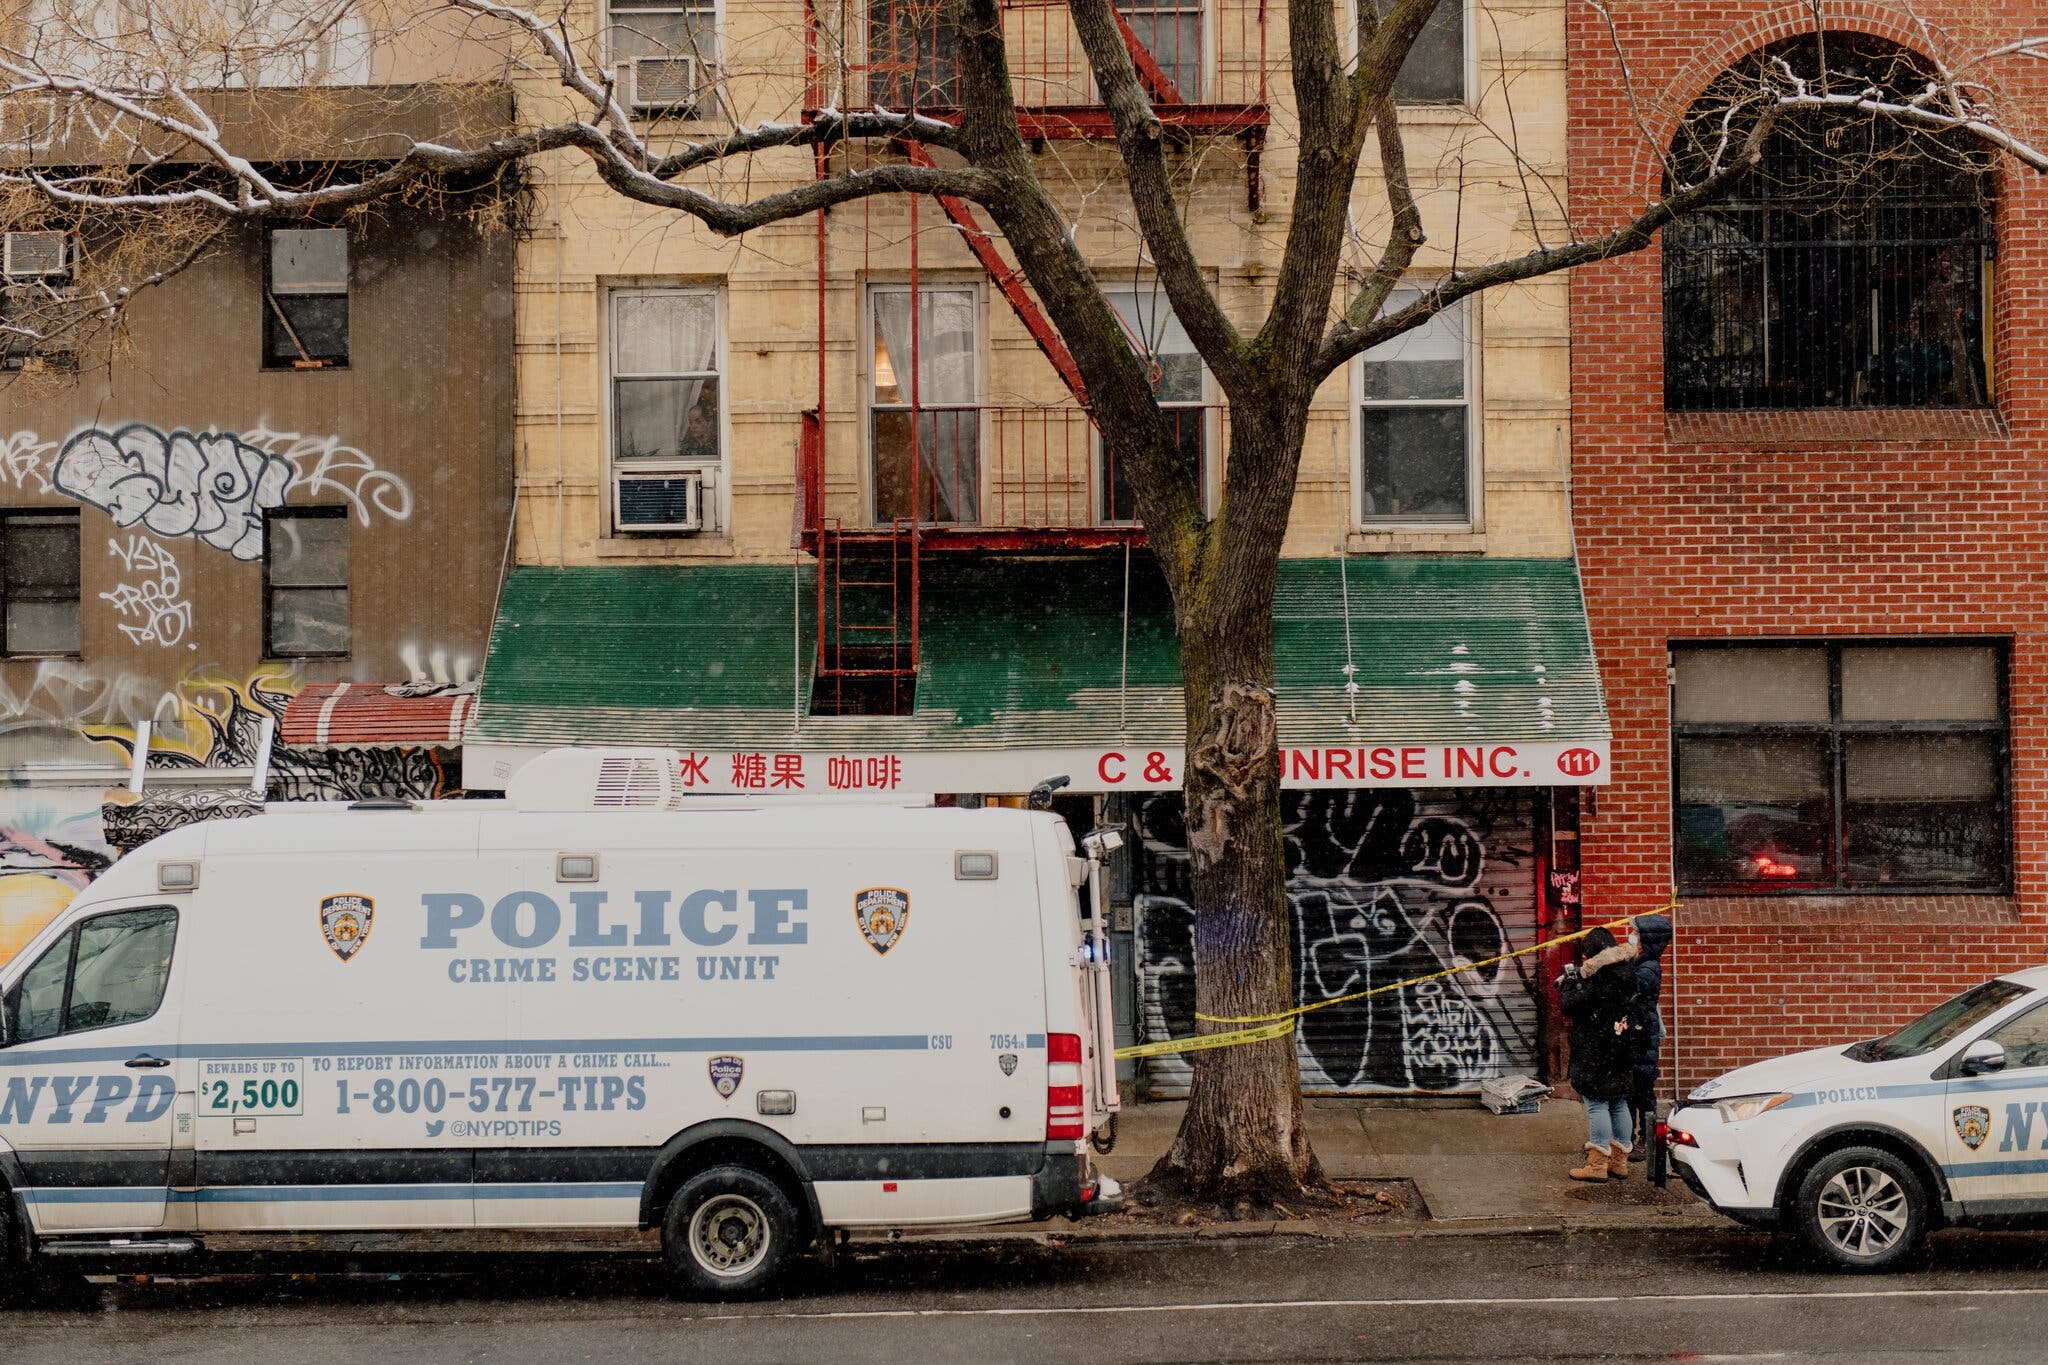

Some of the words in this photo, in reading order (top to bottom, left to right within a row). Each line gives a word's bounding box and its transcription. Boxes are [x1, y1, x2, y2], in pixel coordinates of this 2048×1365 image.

[679, 752, 710, 787] 水
[731, 752, 806, 789] 糖果
[828, 754, 902, 790] 咖啡
[1097, 752, 1127, 784] C
[1143, 751, 1173, 783] &
[1443, 746, 1530, 778] INC.
[1559, 752, 1597, 772] 111
[332, 896, 363, 904] POLICE
[868, 889, 897, 898] POLICE
[323, 903, 371, 916] DEPARTMENT
[858, 898, 907, 910] DEPARTMENT
[420, 888, 808, 950] POLICE
[448, 958, 556, 983] CRIME
[572, 957, 680, 982] SCENE
[696, 956, 779, 980] UNIT
[931, 1034, 953, 1050] CSU
[989, 1034, 1018, 1049] 7054
[206, 1062, 258, 1074] REWARDS
[262, 1062, 277, 1073] UP
[280, 1062, 295, 1073] TO
[312, 1057, 331, 1072] TO
[337, 1056, 393, 1071] REPORT
[399, 1055, 498, 1070] INFORMATION
[504, 1055, 552, 1069] ABOUT
[558, 1054, 568, 1068] A
[573, 1054, 618, 1068] CRIME
[624, 1054, 671, 1067] CALL...
[0, 1075, 176, 1124] NYPD
[202, 1079, 299, 1114] $2,500
[336, 1075, 647, 1114] 1-800-577-TIPS
[1816, 1086, 1876, 1105] POLICE
[450, 1120, 562, 1137] @NYPDTIPS
[1999, 1102, 2048, 1153] N
